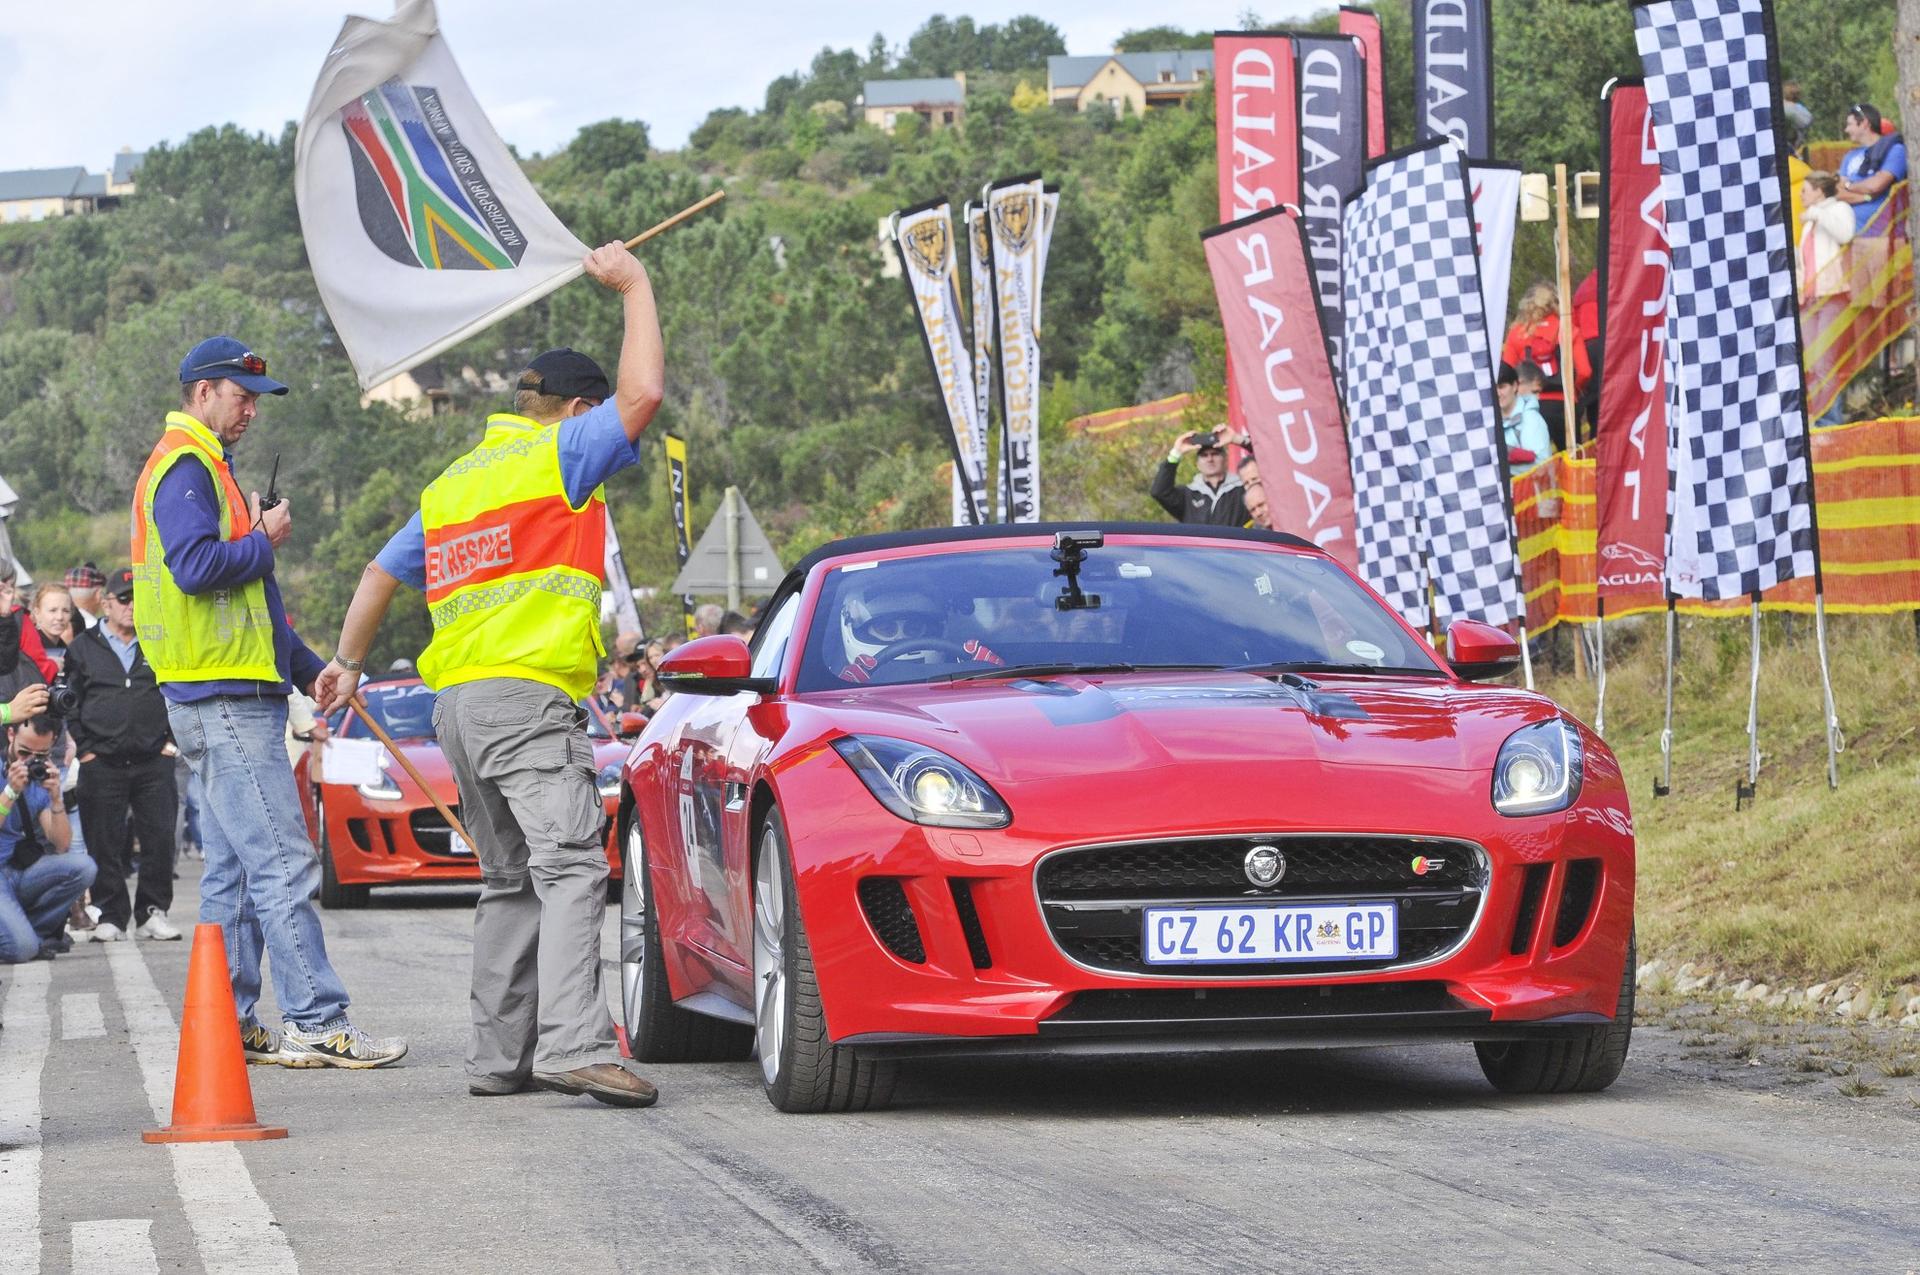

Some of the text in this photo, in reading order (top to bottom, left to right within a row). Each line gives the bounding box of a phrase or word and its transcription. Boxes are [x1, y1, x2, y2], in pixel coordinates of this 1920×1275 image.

[423, 94, 522, 246] MOTORSPORT SOUTH AFRICA
[999, 269, 1030, 433] SECURITY
[448, 528, 511, 578] RESCUE
[1597, 572, 1665, 587] AGUA
[1157, 910, 1385, 955] CZ 62 KR GP
